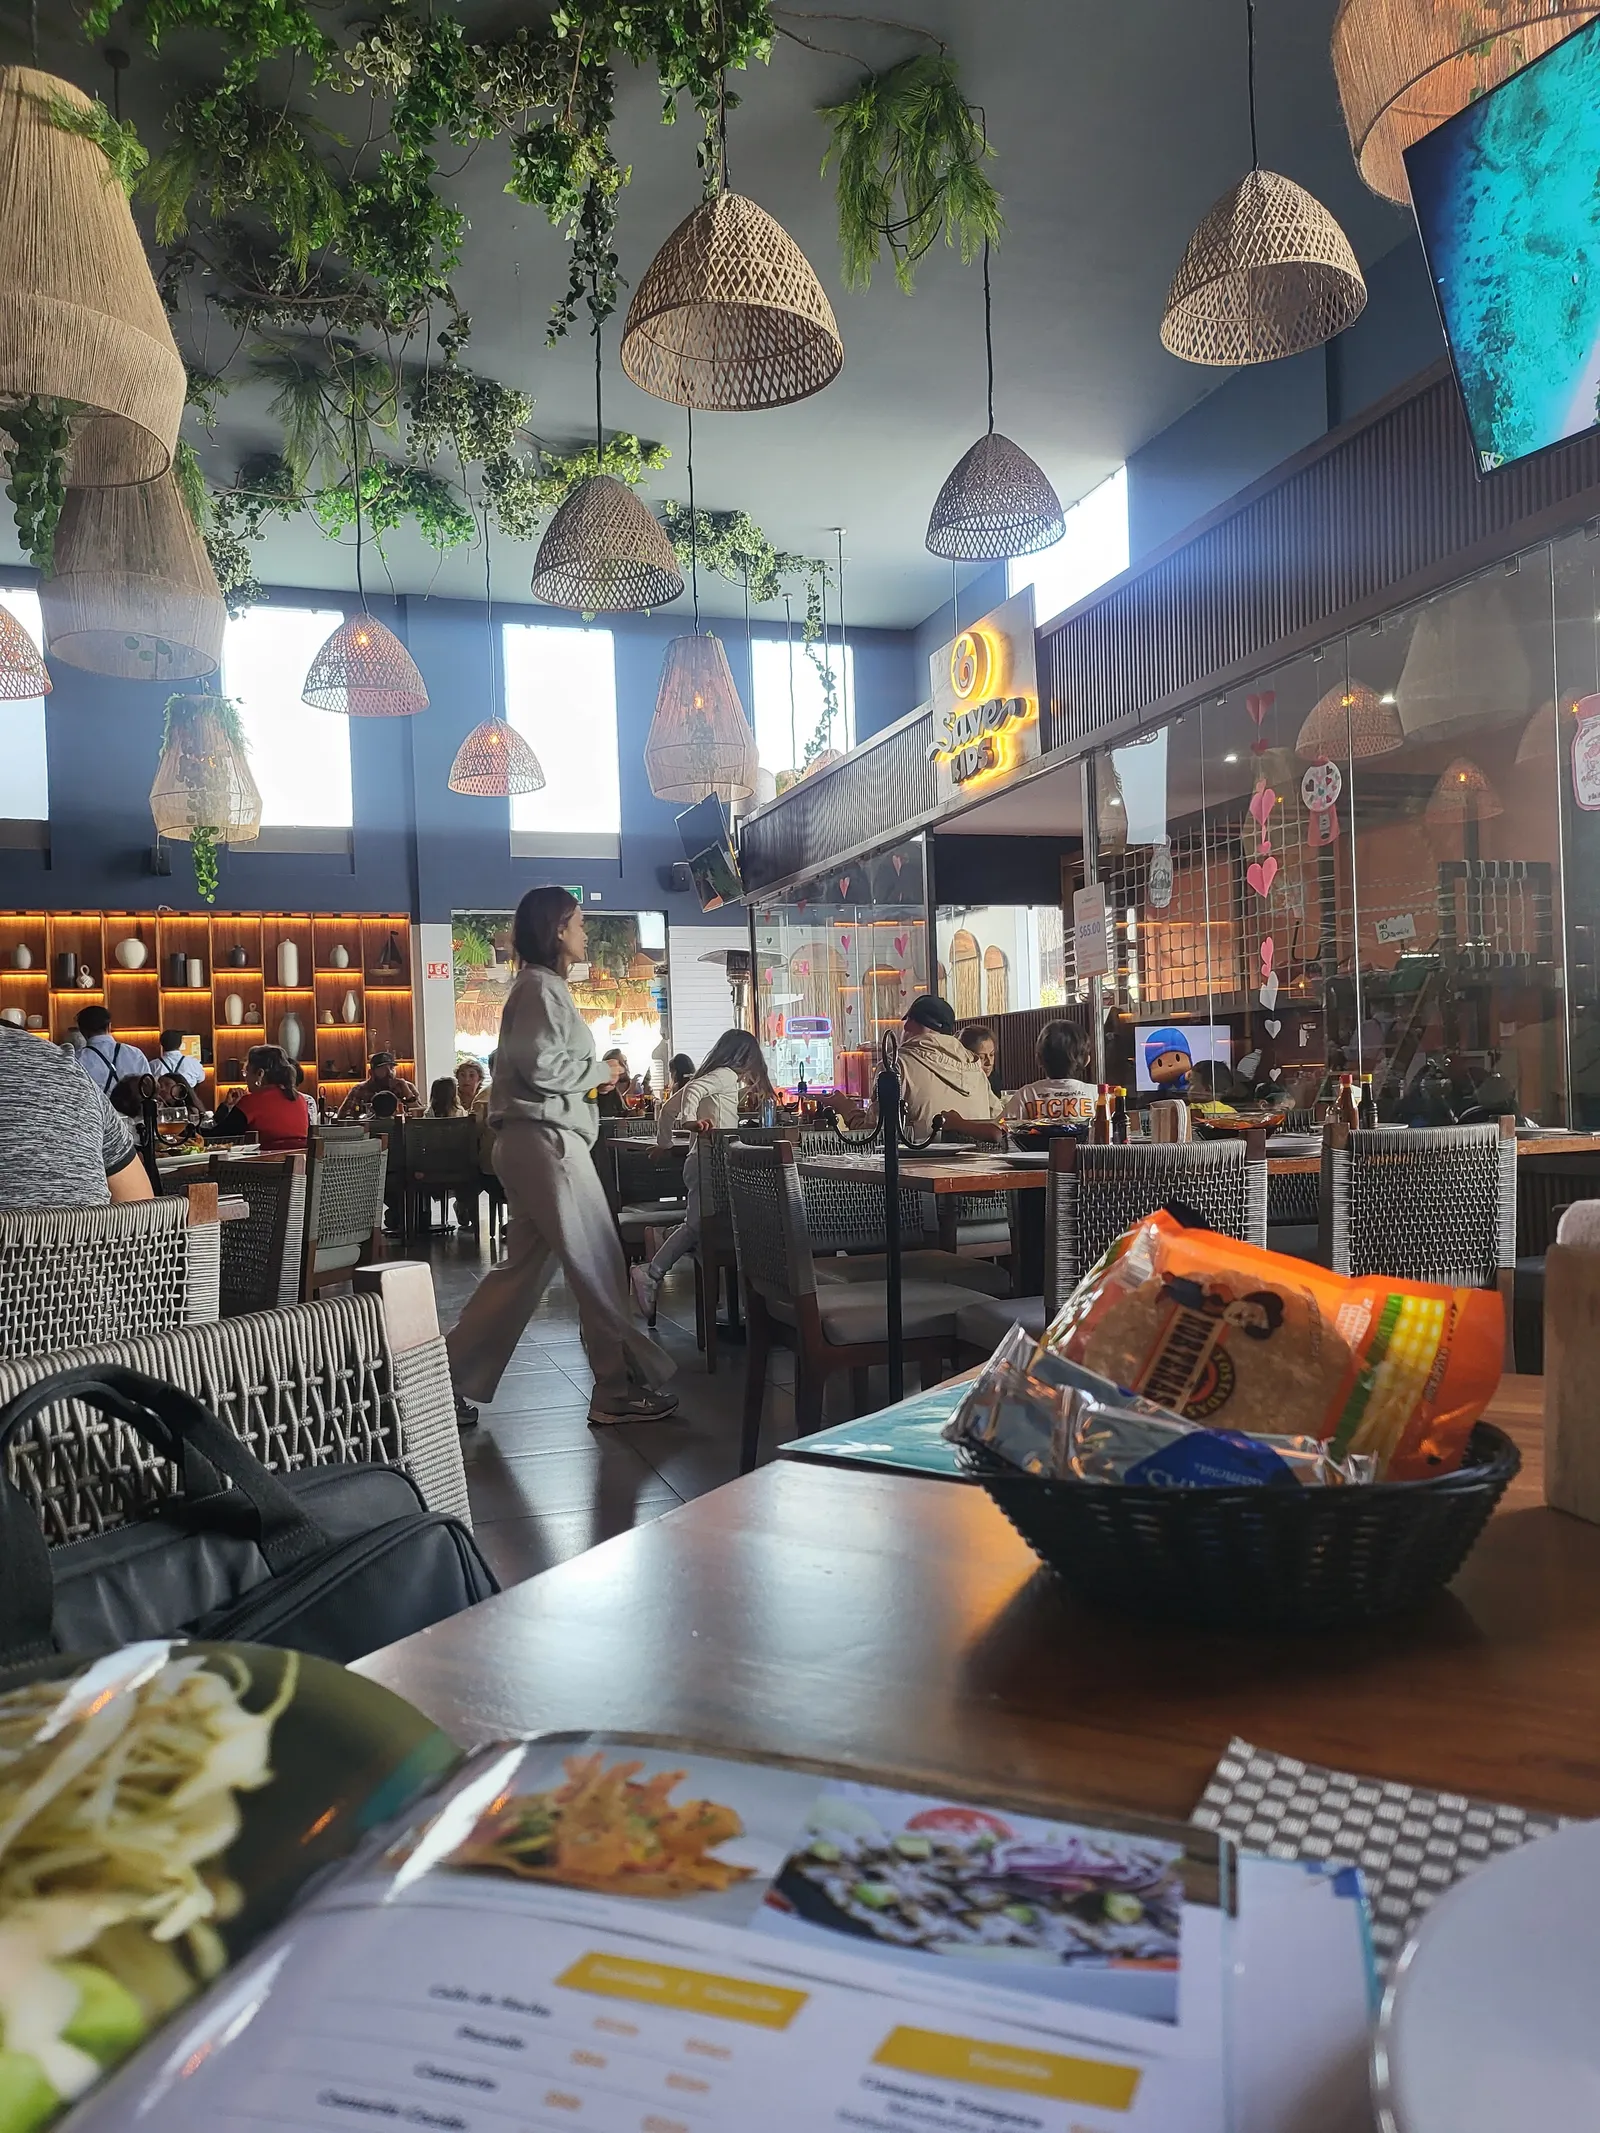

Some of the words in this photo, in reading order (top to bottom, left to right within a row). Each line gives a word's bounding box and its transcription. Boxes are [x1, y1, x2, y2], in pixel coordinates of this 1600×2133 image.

[950, 738, 999, 786] KIDS
[1054, 1090, 1087, 1098] ORIGINAL
[1025, 1098, 1099, 1120] ICKE
